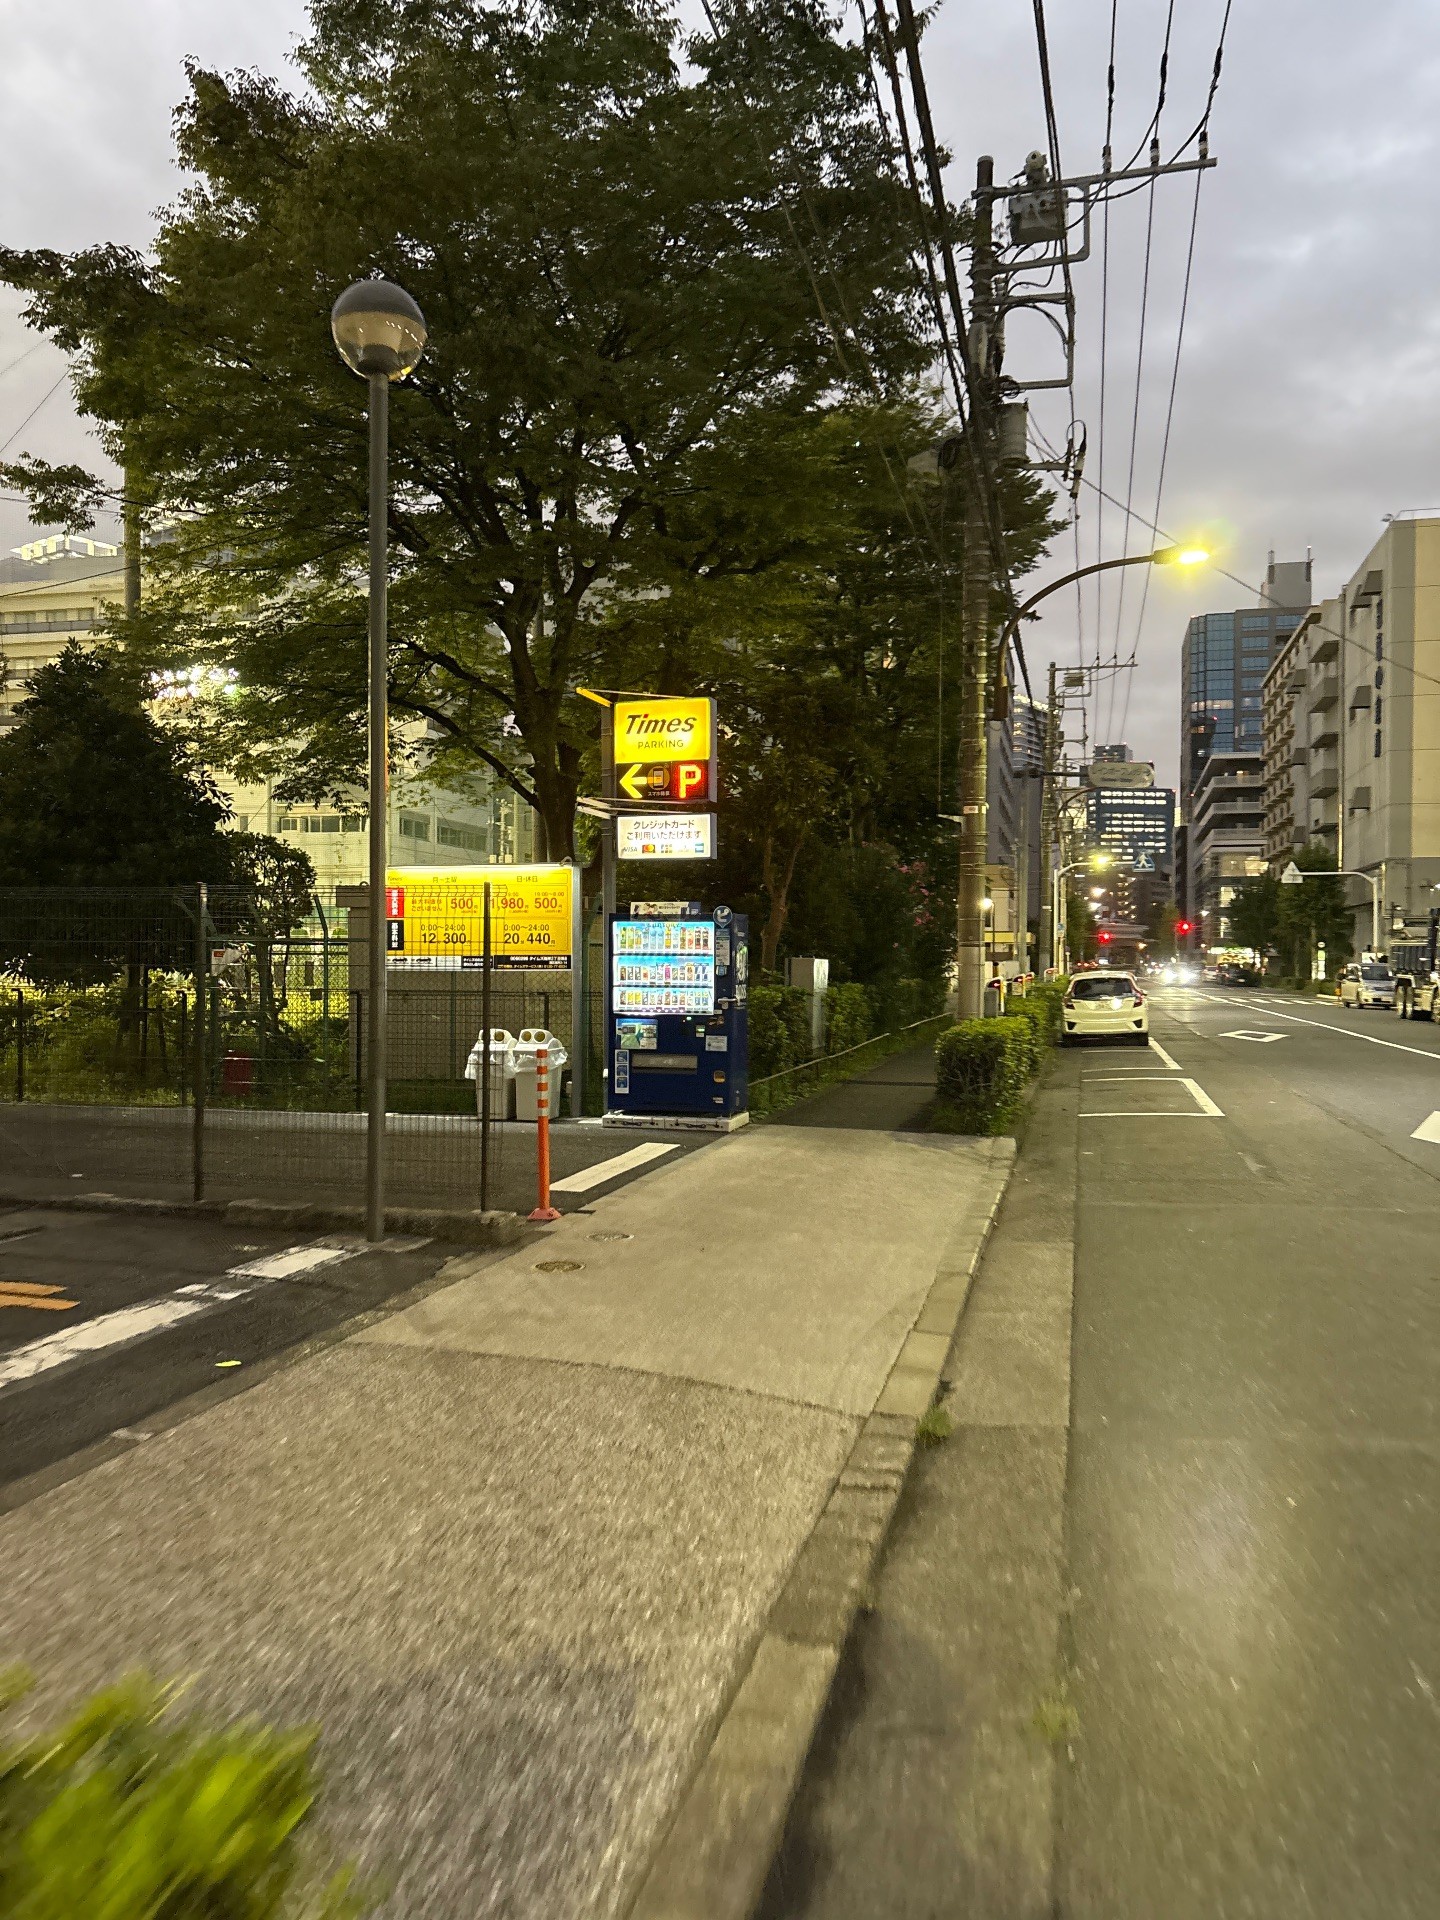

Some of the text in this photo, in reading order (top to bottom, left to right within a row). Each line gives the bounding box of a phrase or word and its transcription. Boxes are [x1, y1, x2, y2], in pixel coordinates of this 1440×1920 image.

[626, 714, 697, 734] Times
[637, 739, 684, 749] PARKING
[679, 764, 701, 799] P
[633, 819, 695, 830] クレジットカード
[626, 830, 702, 841] ご利用いただけます
